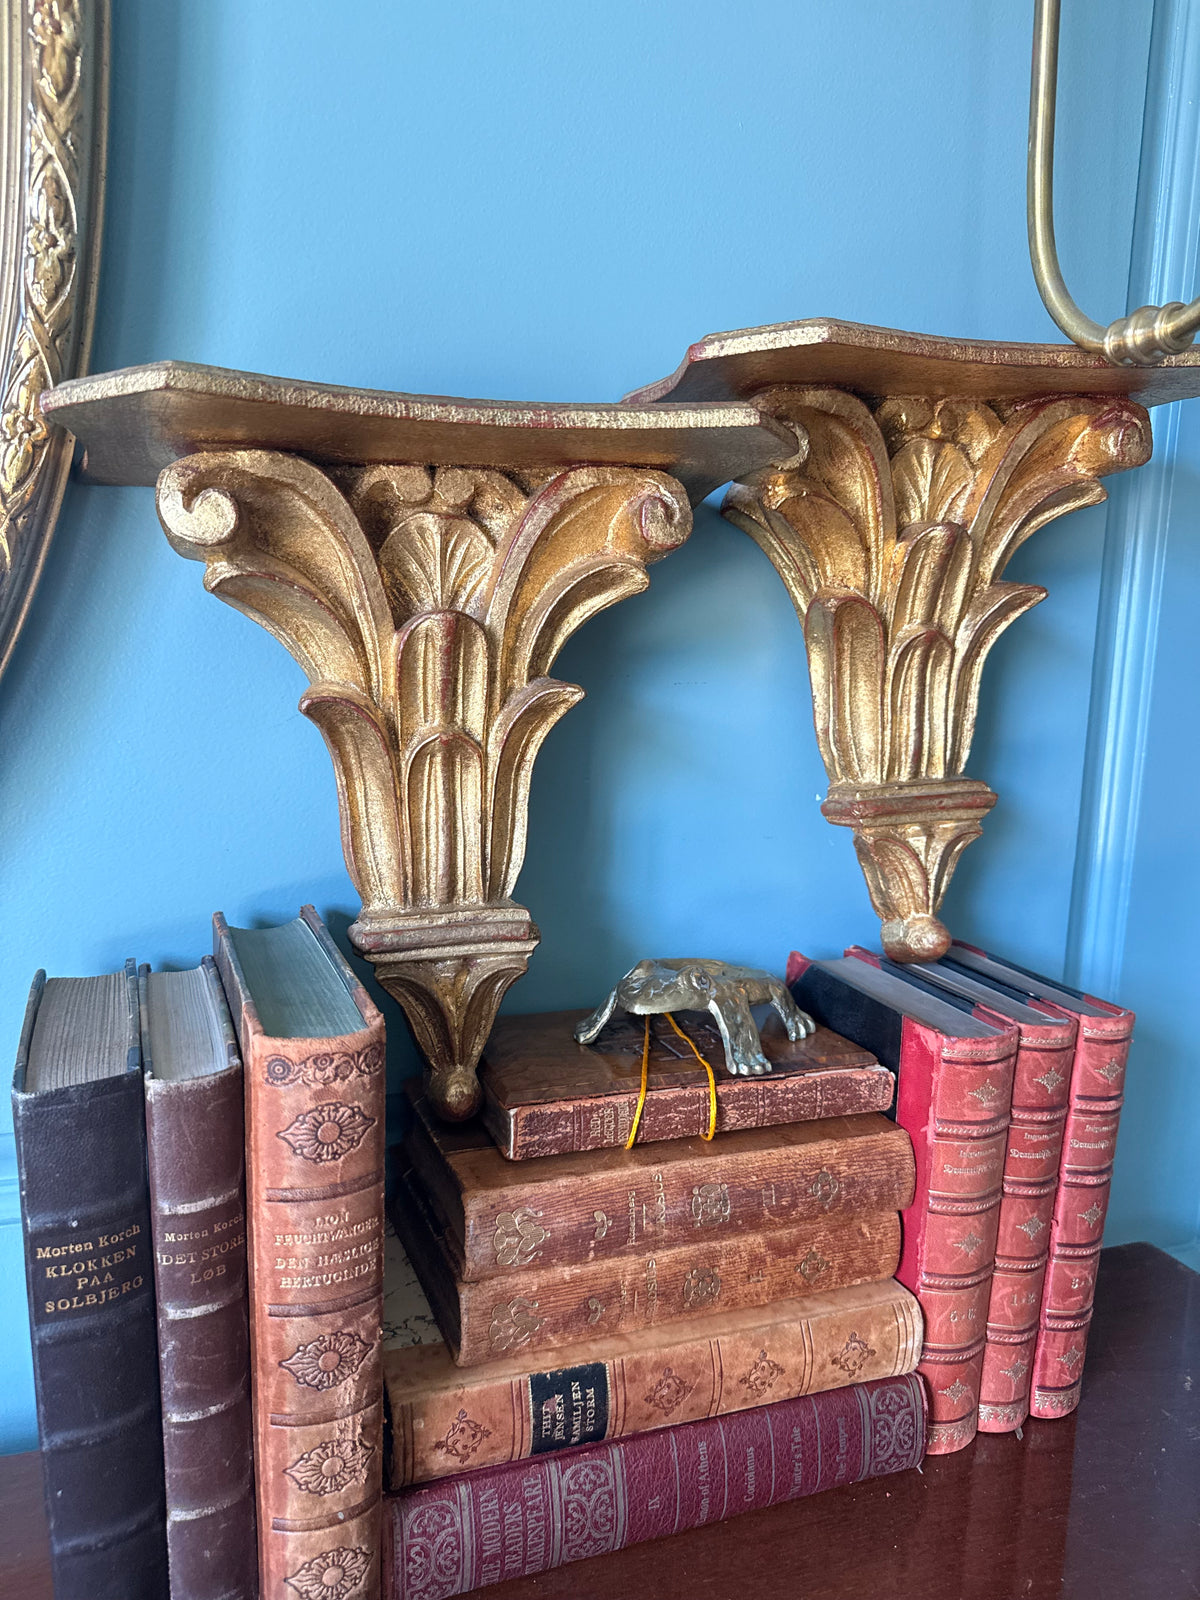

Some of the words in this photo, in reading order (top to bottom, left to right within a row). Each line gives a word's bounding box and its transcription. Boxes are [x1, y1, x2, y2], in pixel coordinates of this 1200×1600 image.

[164, 1230, 209, 1243] Morten
[213, 1213, 245, 1234] Korch
[314, 1208, 350, 1229] LION
[36, 1240, 94, 1260] Morten
[98, 1224, 141, 1248] Korch
[160, 1251, 198, 1266] DET
[200, 1232, 246, 1261] STORE
[45, 1244, 138, 1279] KLOKKEN
[189, 1264, 227, 1286] LØB
[274, 1257, 309, 1270] DEN
[279, 1257, 377, 1289] HERTUGINDE
[44, 1275, 144, 1314] SOLBJERG
[76, 1271, 115, 1291] PAA
[541, 1402, 552, 1438] THIT
[551, 1393, 566, 1441] JENSEN
[569, 1381, 585, 1445] FAMILJEN
[585, 1386, 596, 1432] STORM
[790, 1425, 802, 1452] Tale
[698, 1440, 710, 1481] Athens
[743, 1446, 756, 1502] Coriolanus
[647, 1495, 660, 1511] IX
[479, 1486, 502, 1558] MODERN
